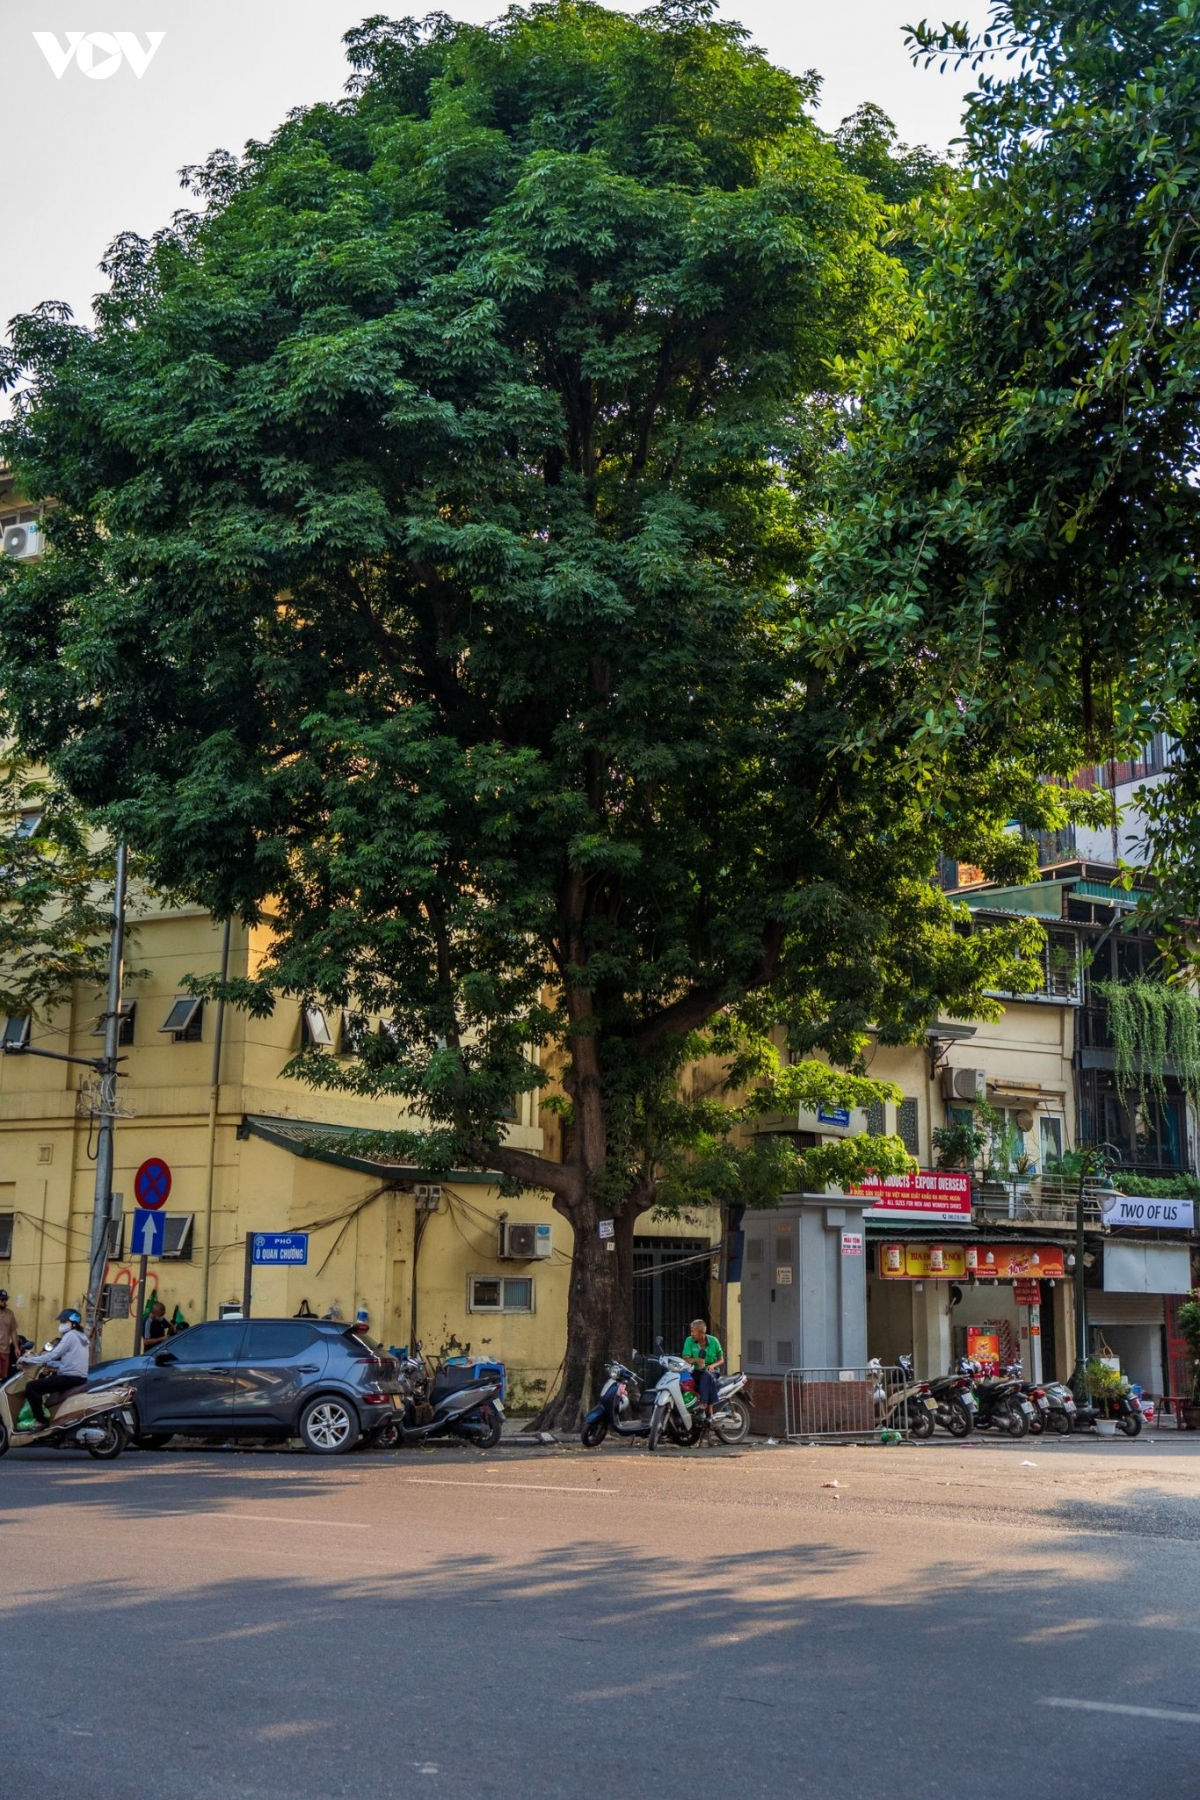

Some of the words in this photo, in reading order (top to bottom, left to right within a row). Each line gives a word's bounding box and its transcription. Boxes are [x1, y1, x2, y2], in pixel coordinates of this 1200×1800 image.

[915, 1175, 937, 1190] EXPORT
[938, 1177, 967, 1192] OVERSEAS
[1120, 1203, 1144, 1219] TWO
[1147, 1204, 1162, 1220] OF
[1163, 1206, 1178, 1221] US
[262, 1248, 278, 1260] QUAN
